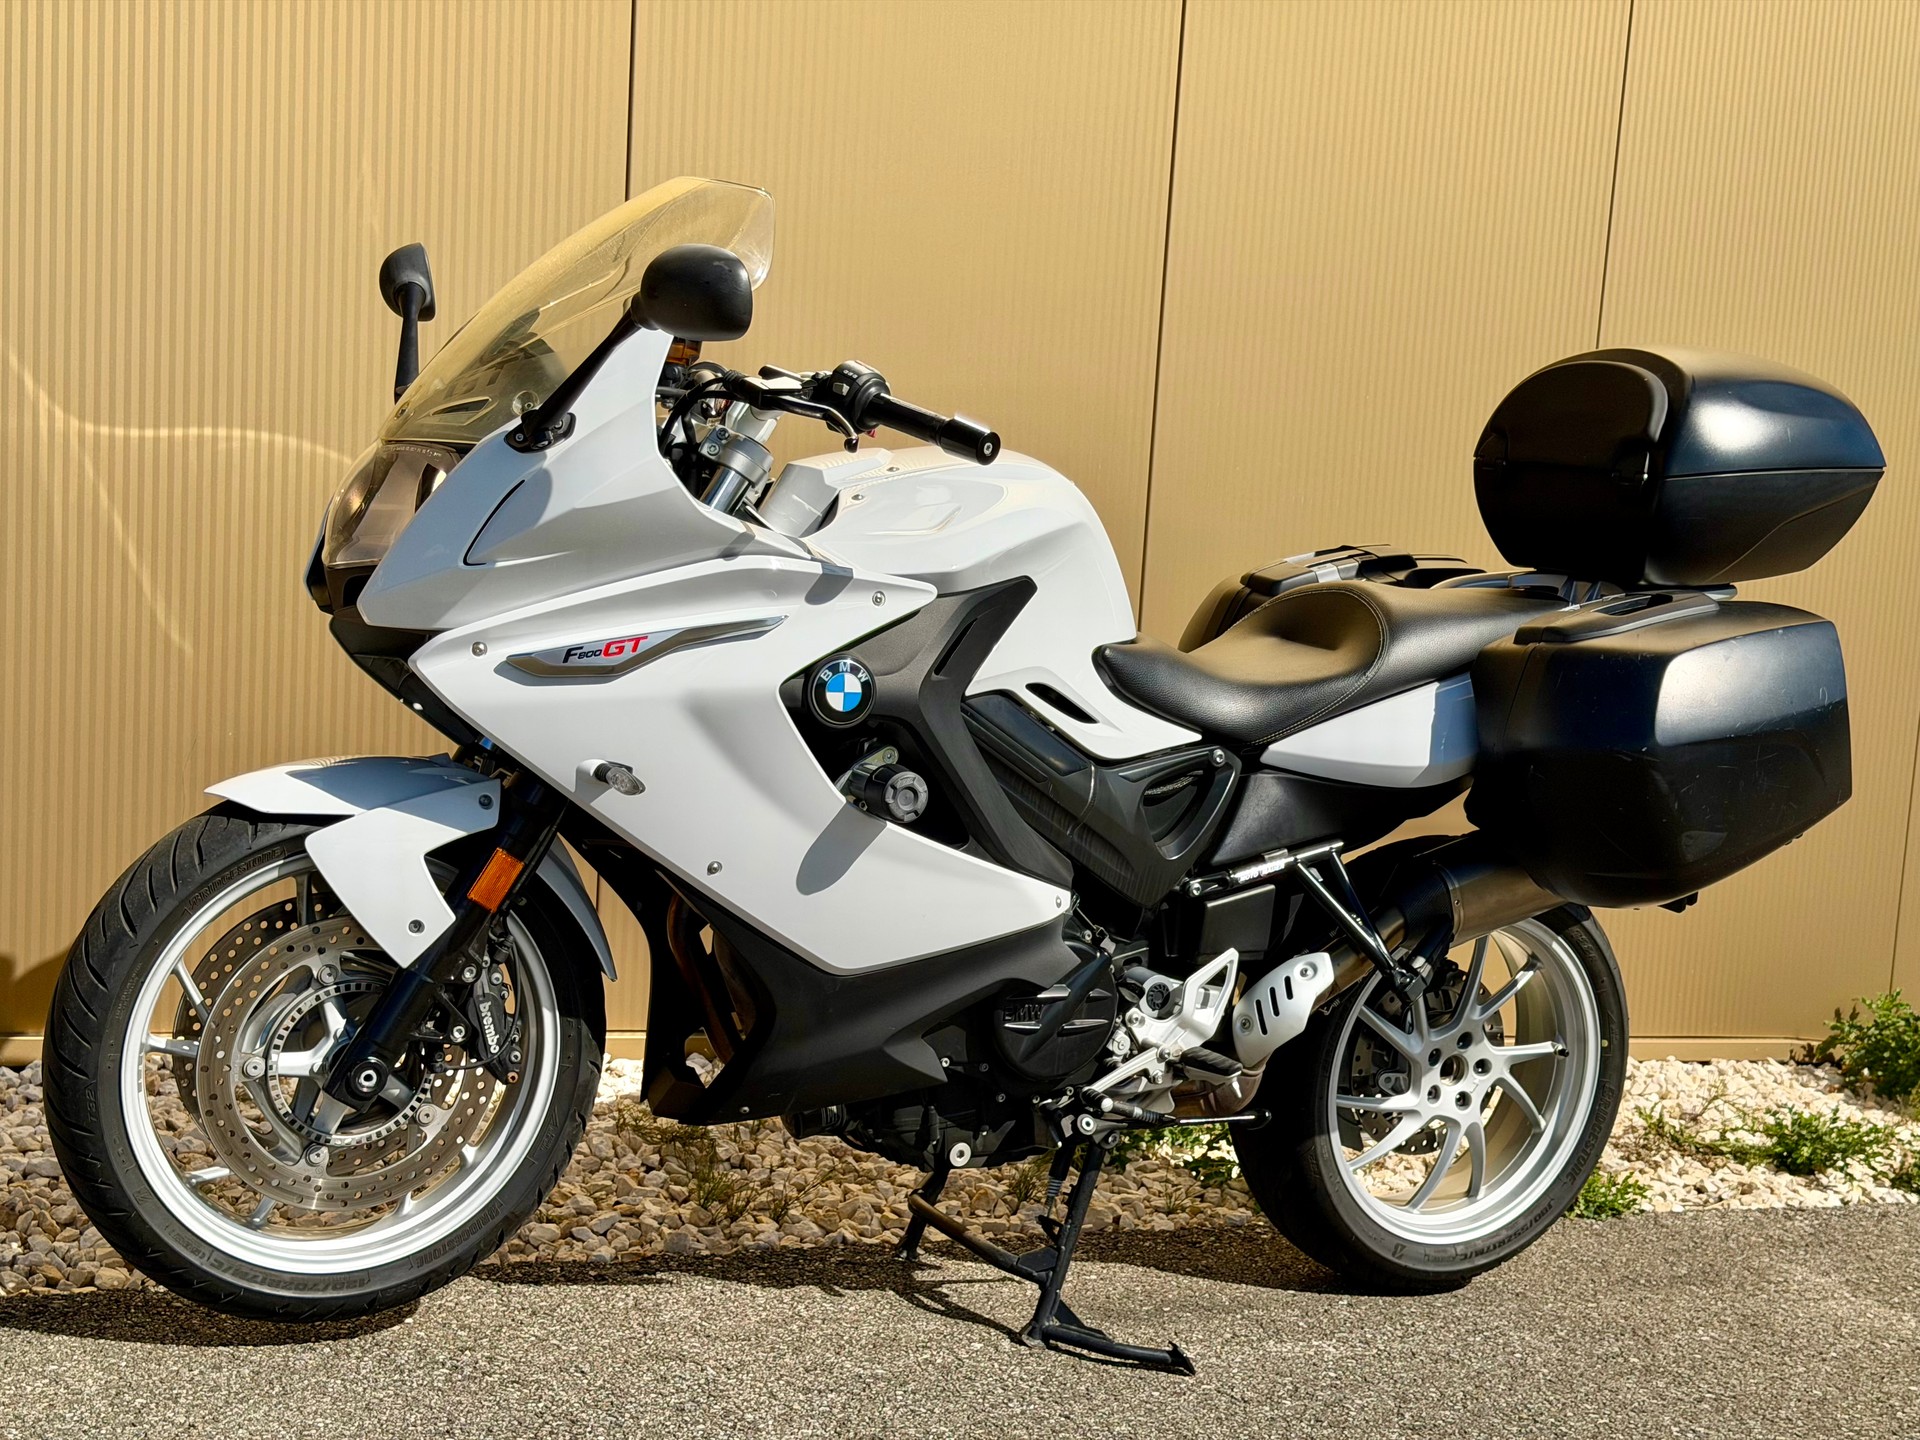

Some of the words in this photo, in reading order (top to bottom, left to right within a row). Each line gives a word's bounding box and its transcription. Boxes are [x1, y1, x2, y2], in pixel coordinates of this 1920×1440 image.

[562, 635, 648, 664] F800GT
[819, 660, 870, 684] BMW
[478, 1000, 500, 1054] brembo
[1565, 1087, 1615, 1185] BRIDGESTONE
[415, 1206, 500, 1268] BRIDGESTONE
